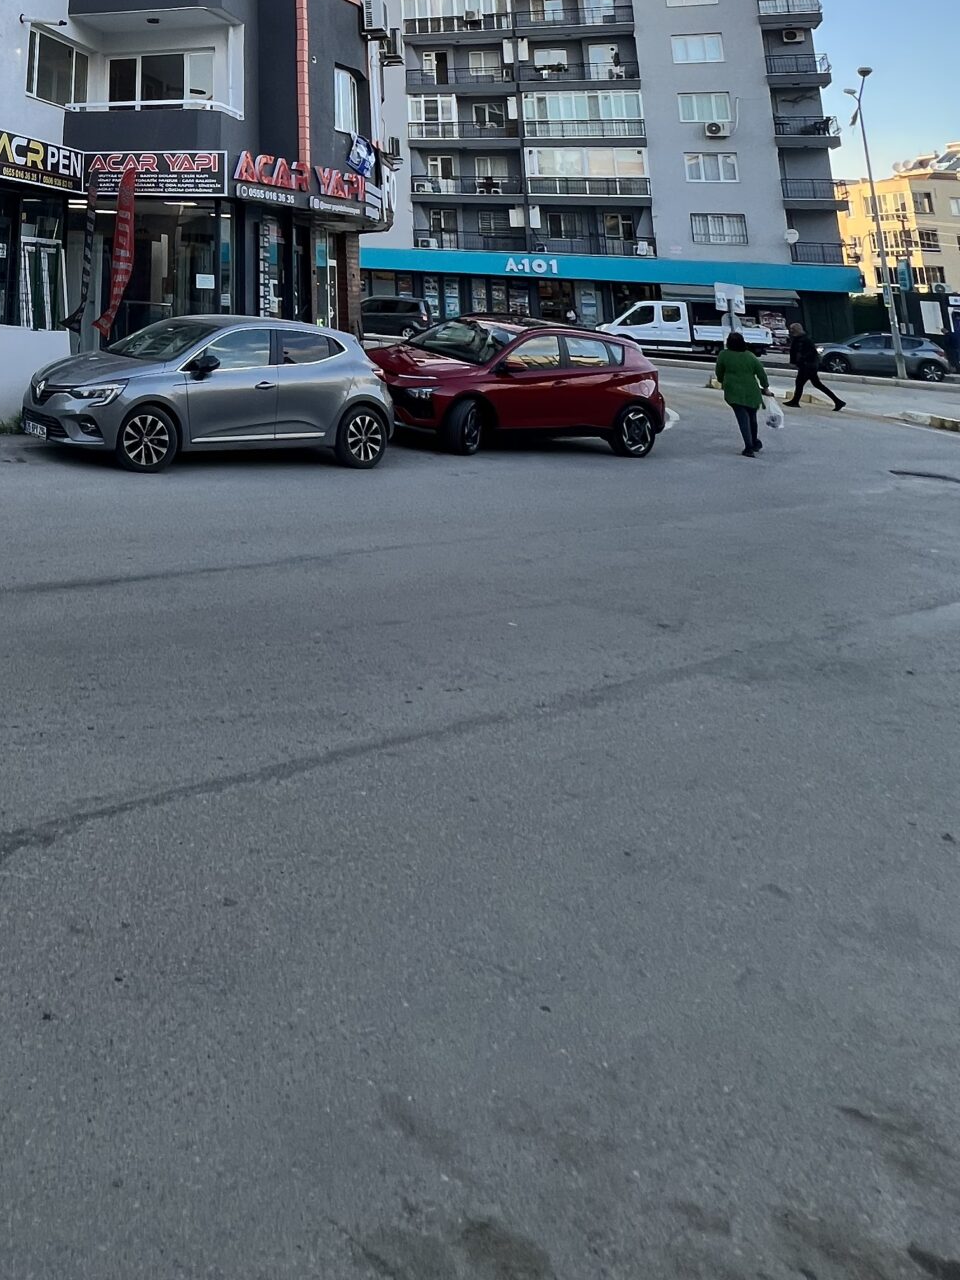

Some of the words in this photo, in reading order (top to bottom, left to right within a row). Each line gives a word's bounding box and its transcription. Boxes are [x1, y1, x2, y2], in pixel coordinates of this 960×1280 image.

[47, 145, 81, 178] PEN
[88, 154, 159, 172] ACAR
[163, 153, 219, 172] YAPI
[233, 150, 310, 192] ACAR
[314, 165, 366, 202] YAPI
[248, 188, 265, 199] 0555
[265, 191, 277, 201] 016
[286, 194, 295, 204] 35
